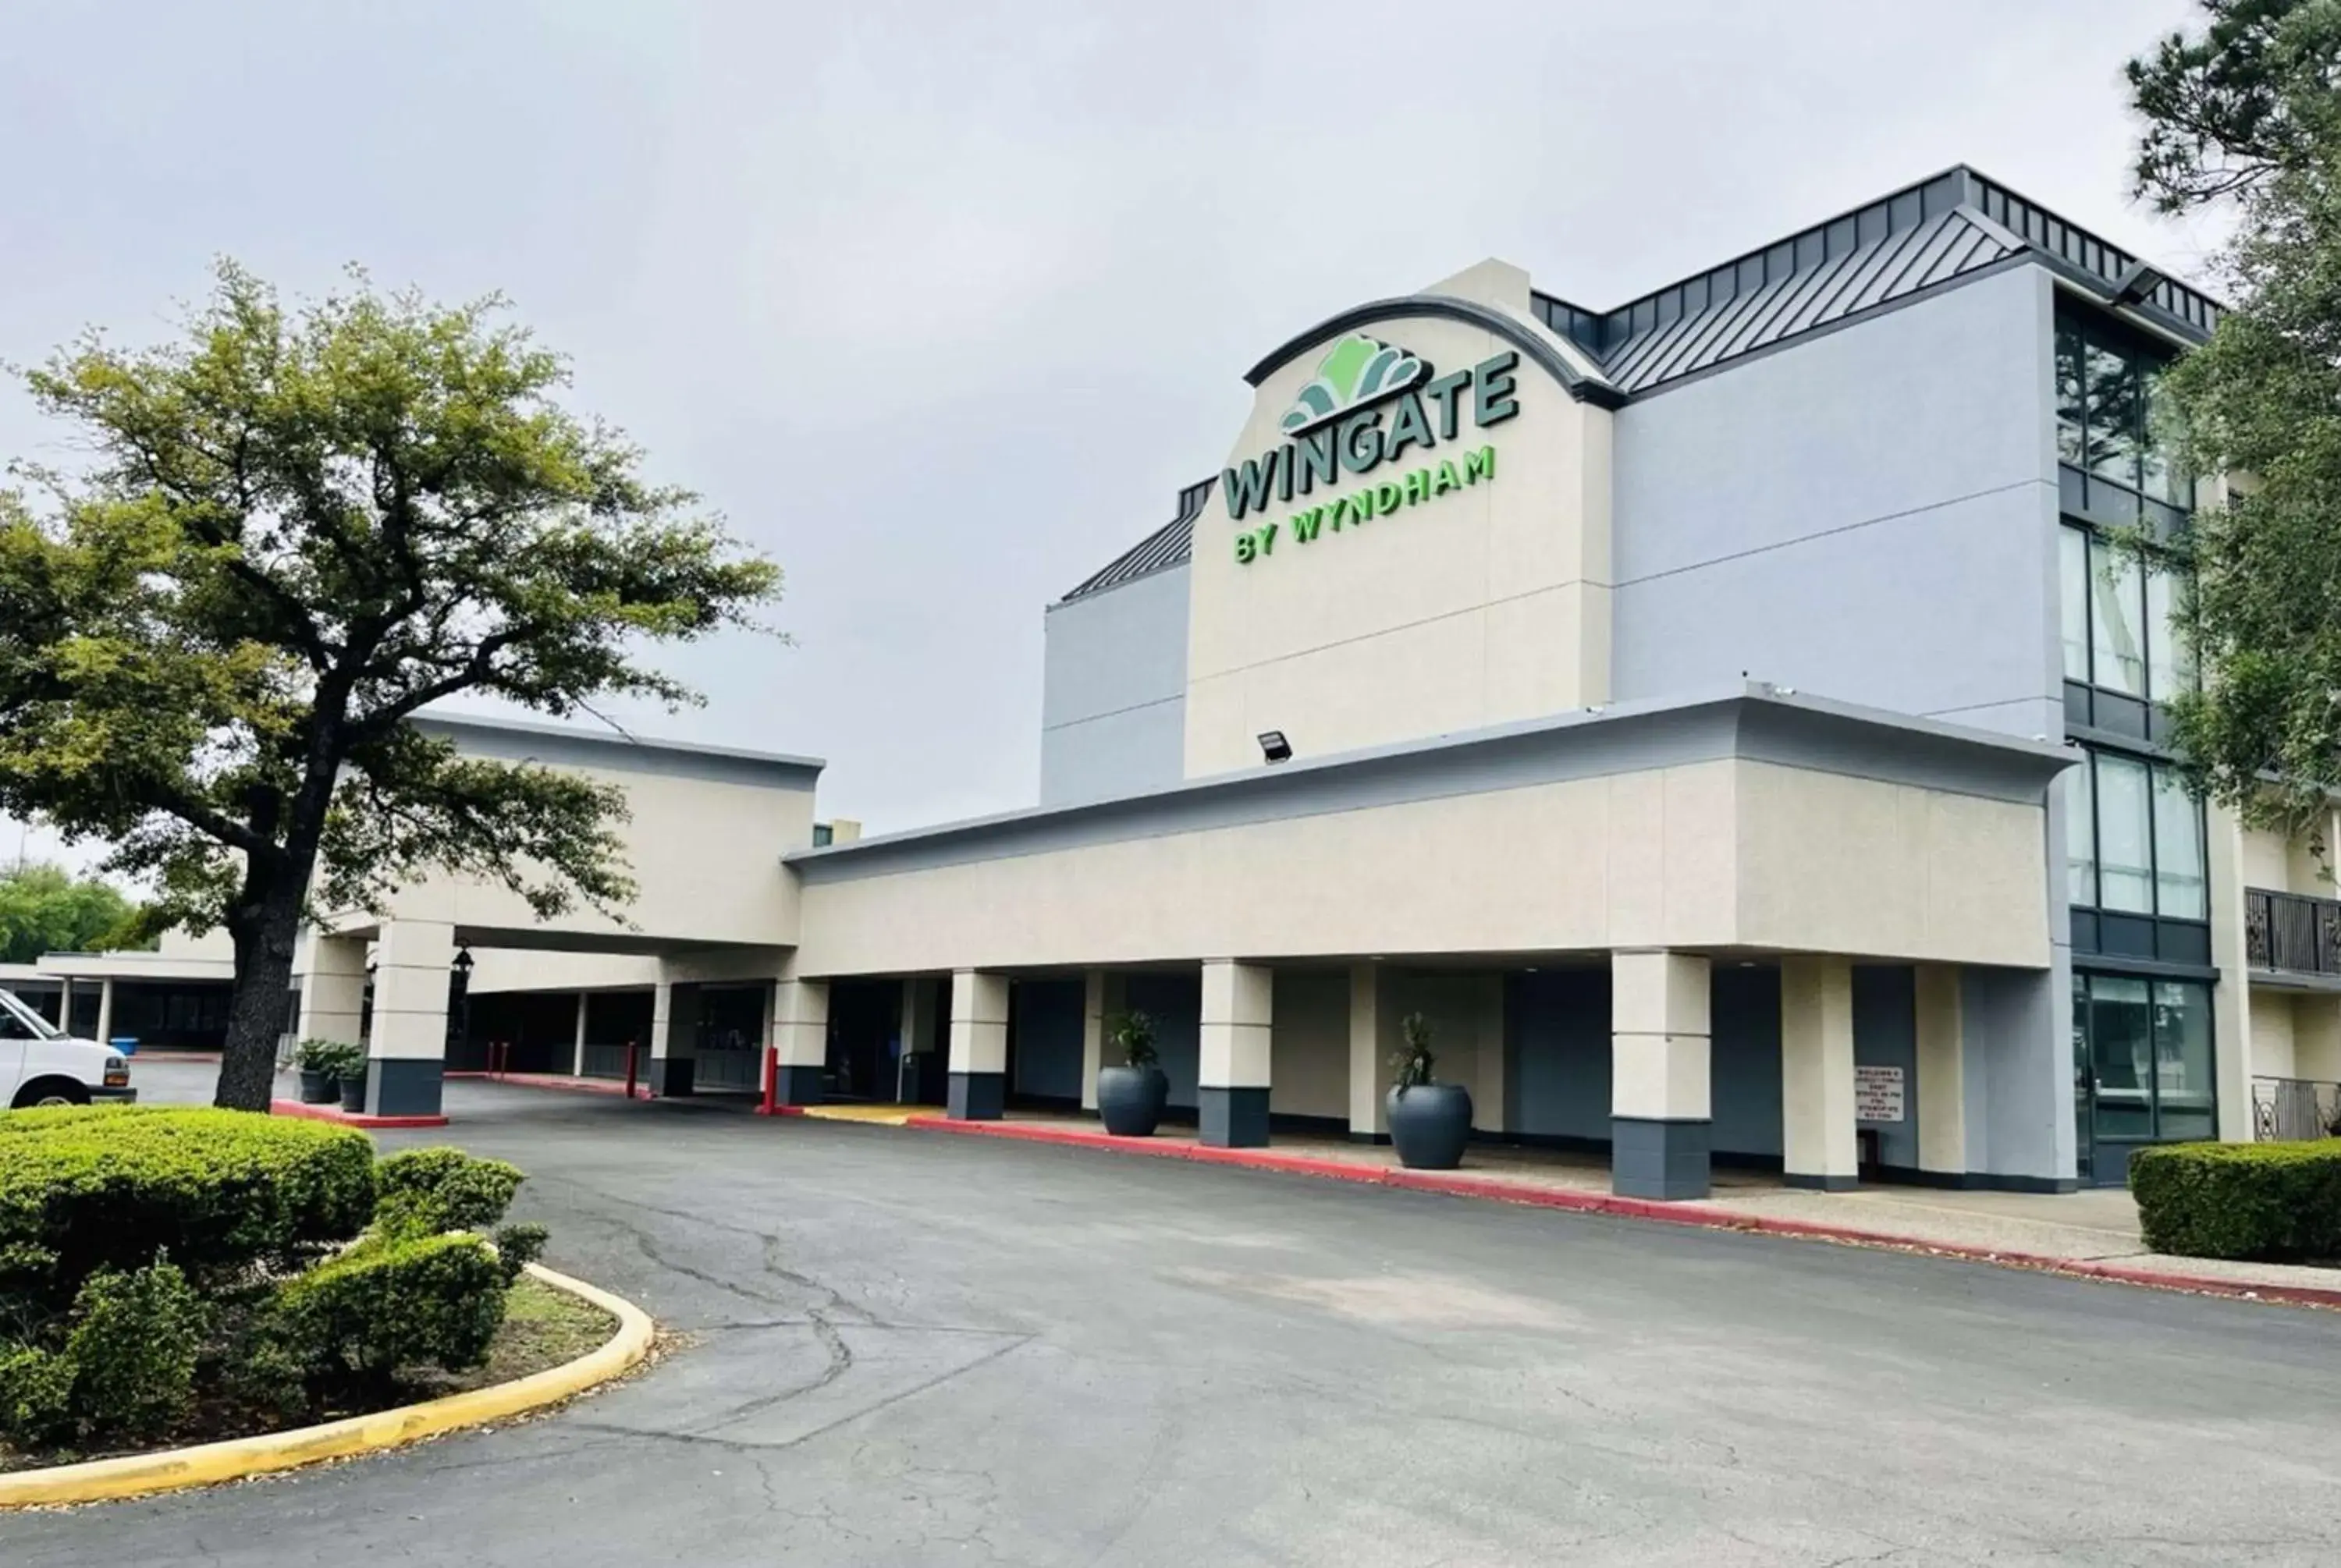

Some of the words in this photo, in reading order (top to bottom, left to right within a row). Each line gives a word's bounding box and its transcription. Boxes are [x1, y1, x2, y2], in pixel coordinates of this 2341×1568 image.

[1222, 351, 1519, 520] WINGATE
[1234, 523, 1278, 564] BY
[1290, 445, 1496, 543] WYNDHAM
